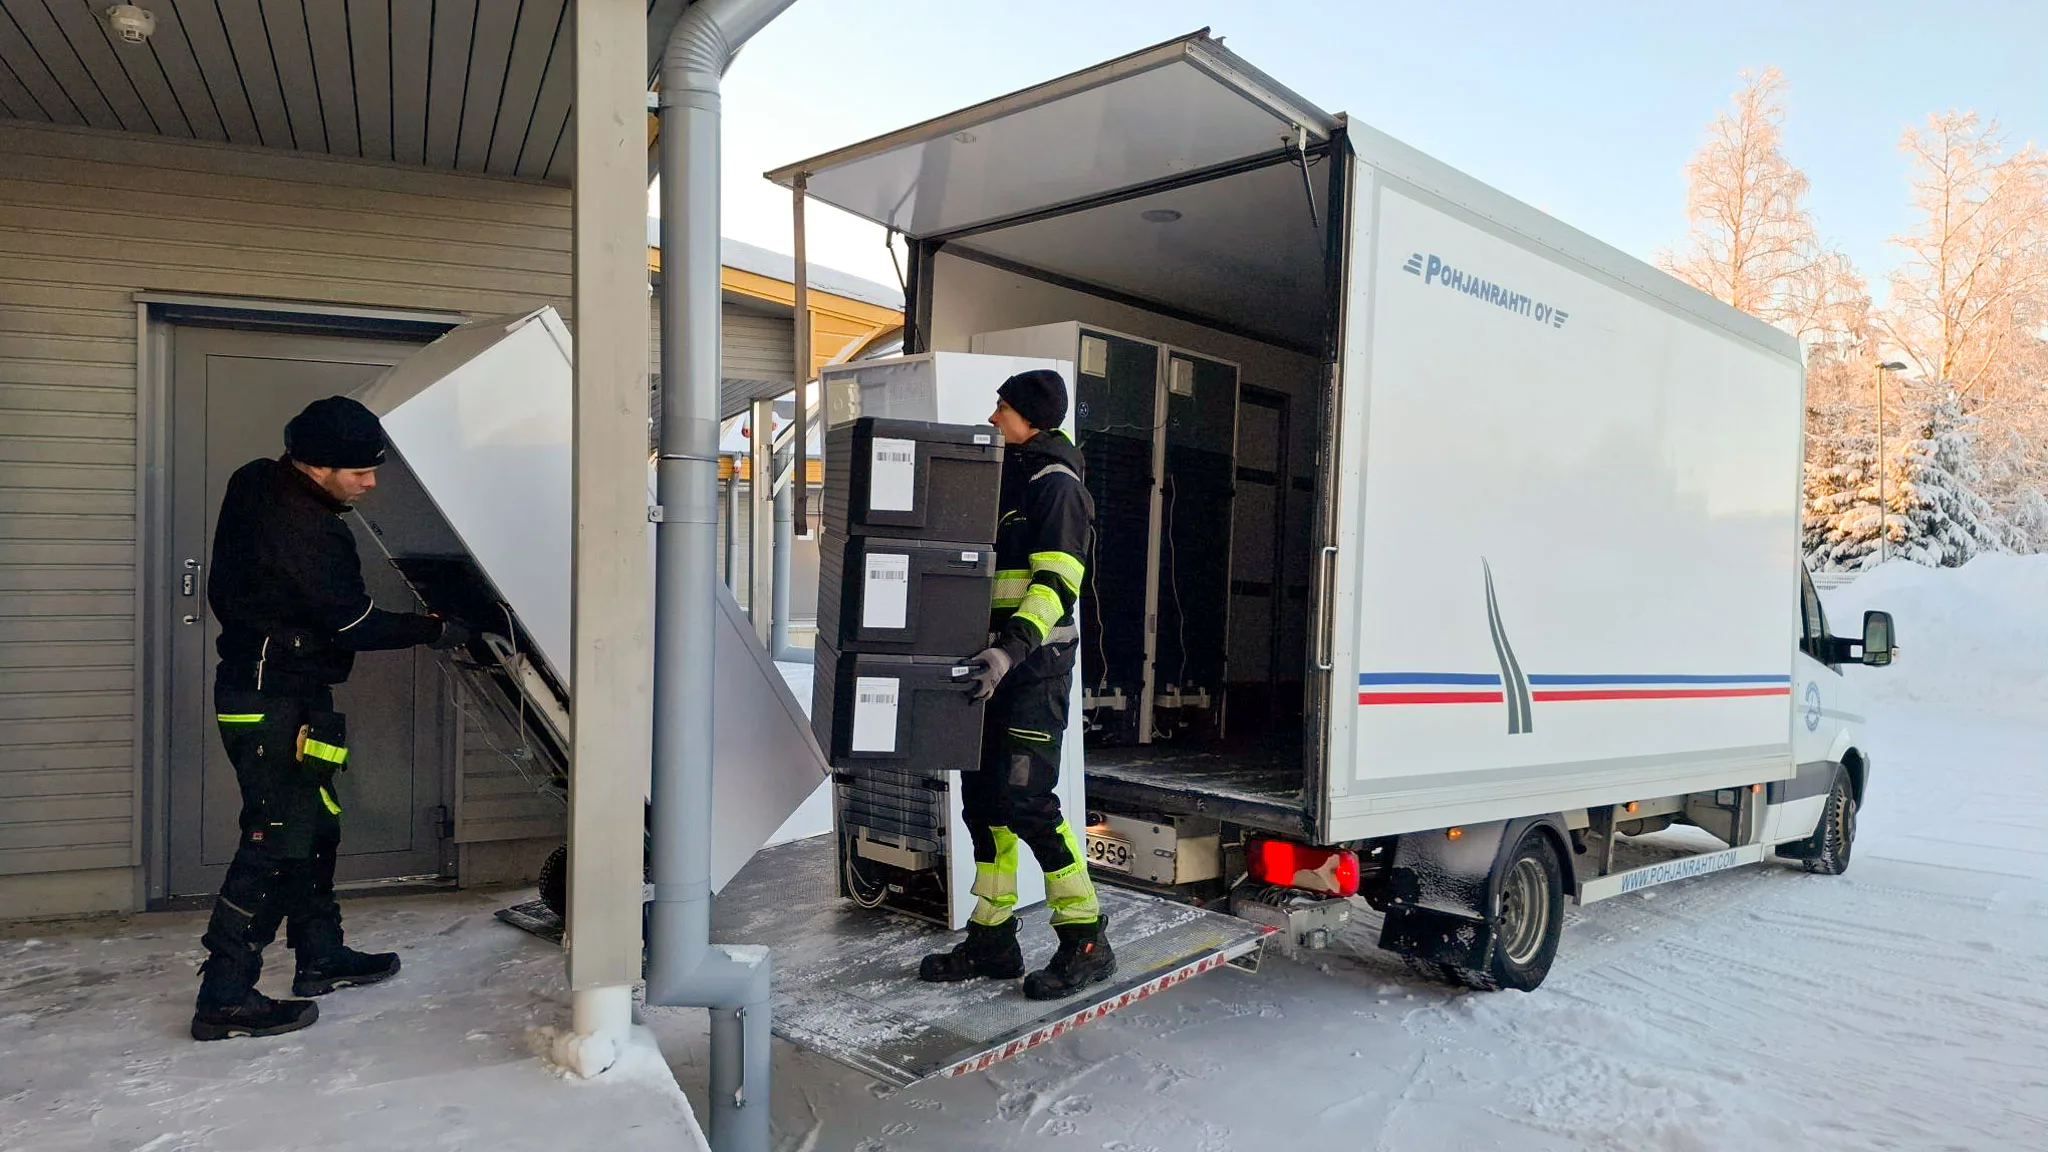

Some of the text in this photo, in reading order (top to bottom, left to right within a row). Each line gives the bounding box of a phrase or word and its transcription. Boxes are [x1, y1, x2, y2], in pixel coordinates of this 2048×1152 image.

[1425, 254, 1553, 325] POHJANRAHTI OY
[1621, 851, 1737, 892] WWW.POHJANRAHTI.COM
